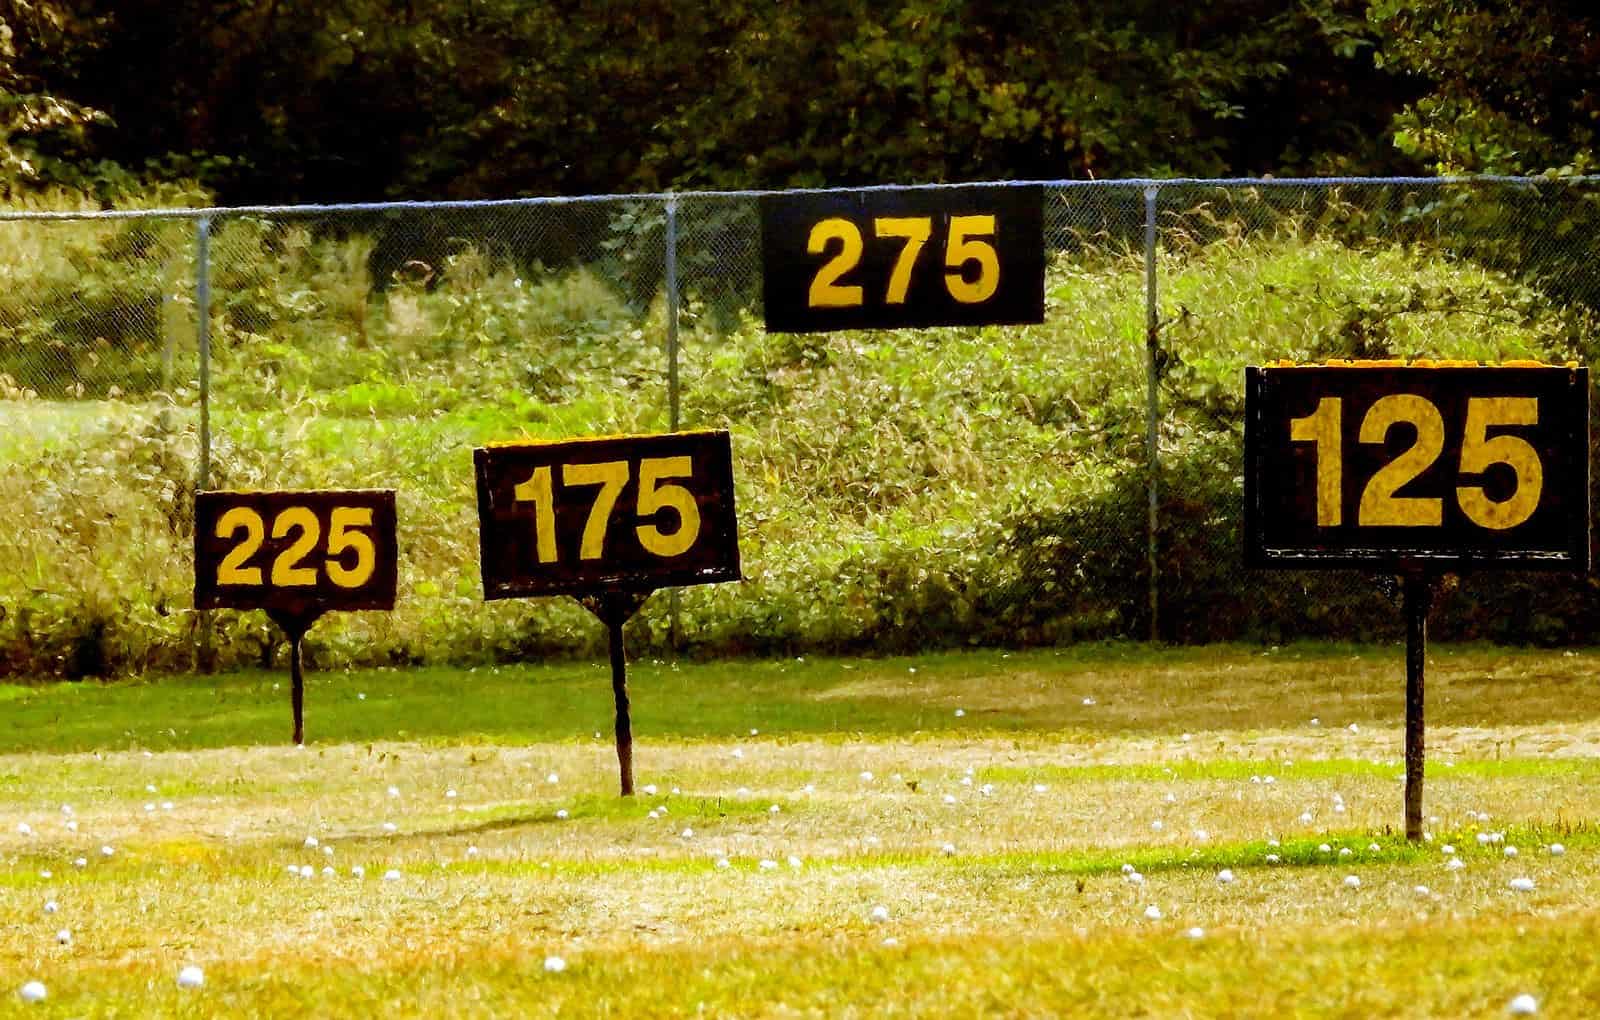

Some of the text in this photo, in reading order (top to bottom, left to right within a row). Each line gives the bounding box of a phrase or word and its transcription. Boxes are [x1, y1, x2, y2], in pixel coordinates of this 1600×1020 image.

[806, 214, 1000, 307] 275
[514, 456, 702, 564] 175
[1290, 394, 1543, 530] 125
[215, 507, 376, 589] 225
